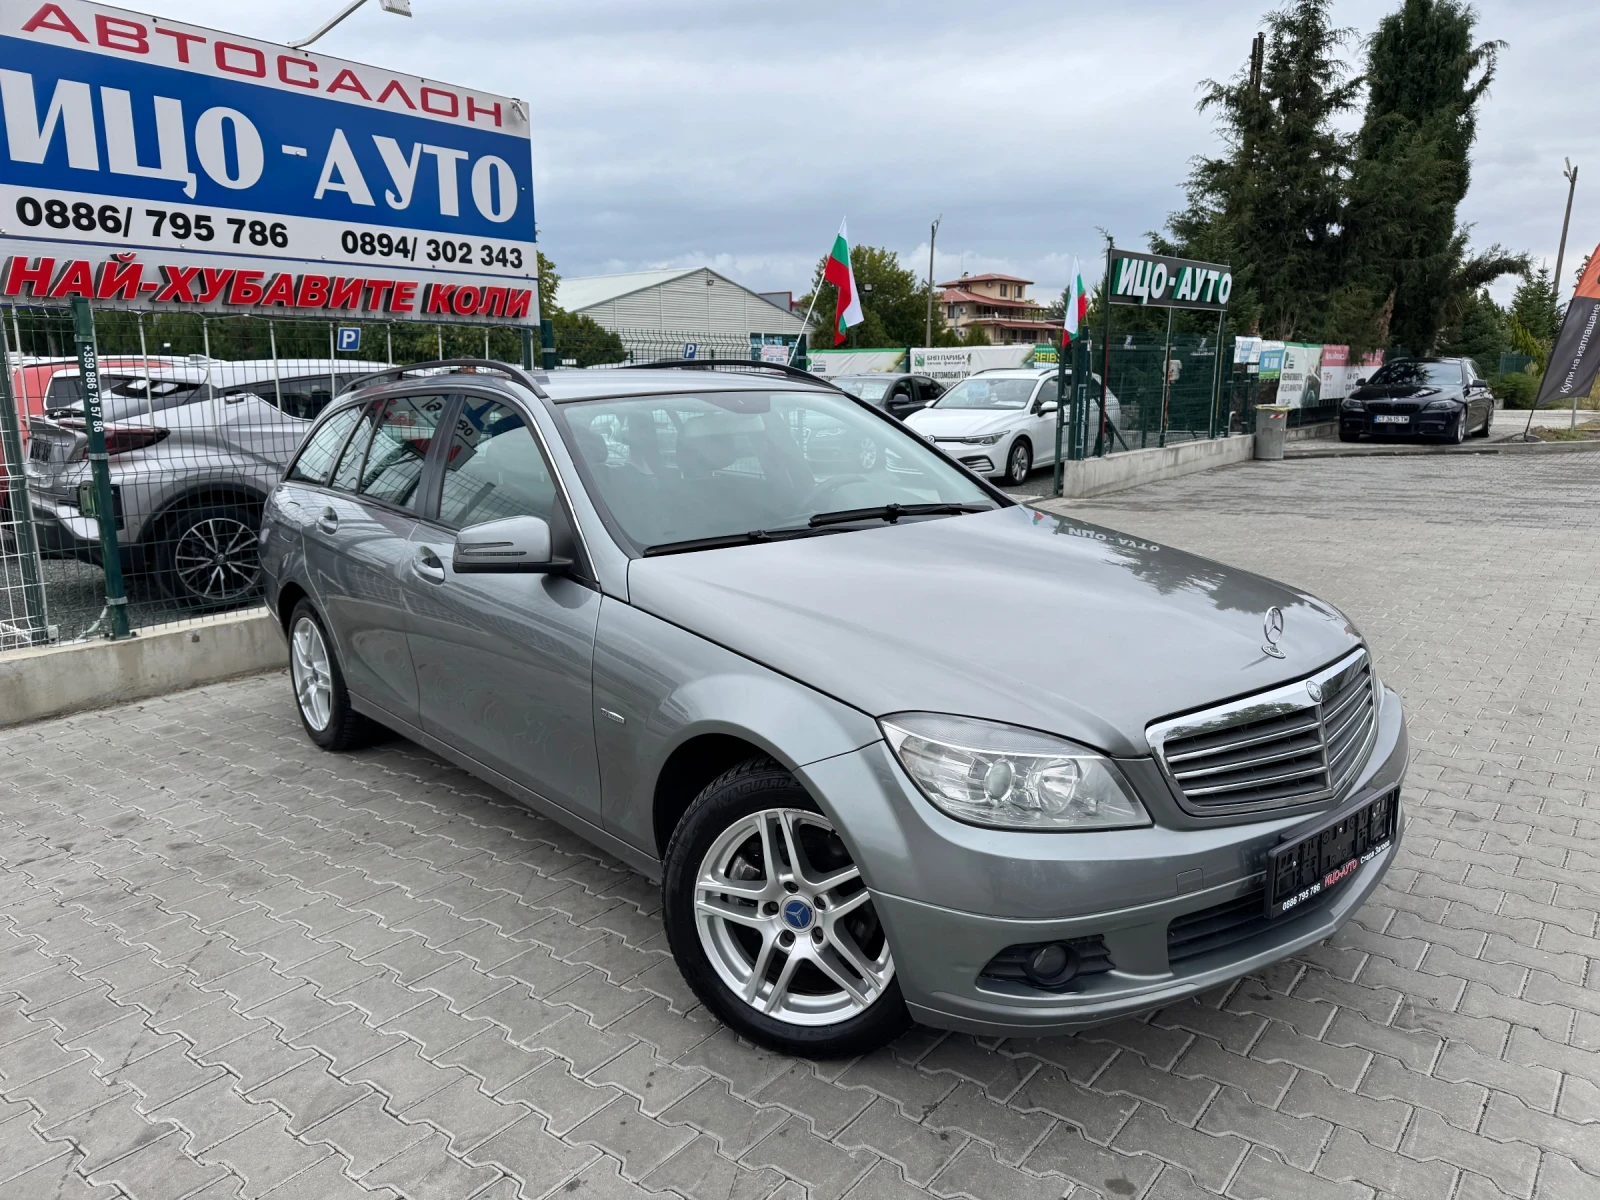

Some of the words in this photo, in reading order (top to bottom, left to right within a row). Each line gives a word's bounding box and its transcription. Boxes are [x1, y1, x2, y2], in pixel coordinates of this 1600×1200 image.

[21, 2, 502, 128] АВТОСАЛОН
[15, 196, 133, 238] 0886/
[145, 209, 215, 242] 795
[226, 216, 289, 248] 786
[340, 230, 418, 261] 0894/
[426, 238, 472, 265] 302
[480, 244, 523, 269] 343
[3, 252, 418, 312] НАЙ-ХУБАВИТЕ
[426, 282, 533, 319] КОЛИ
[83, 345, 95, 369] +359
[1560, 371, 1575, 394] Купи
[1571, 358, 1581, 370] на
[1576, 304, 1600, 357] изплащане
[85, 371, 97, 389] 886
[931, 371, 961, 379] АВТОМОБИЛ
[88, 392, 99, 404] 79
[91, 406, 102, 417] 57
[93, 420, 104, 433] 86
[1282, 896, 1298, 911] 0886
[1298, 889, 1309, 902] 795
[1310, 882, 1321, 896] 786
